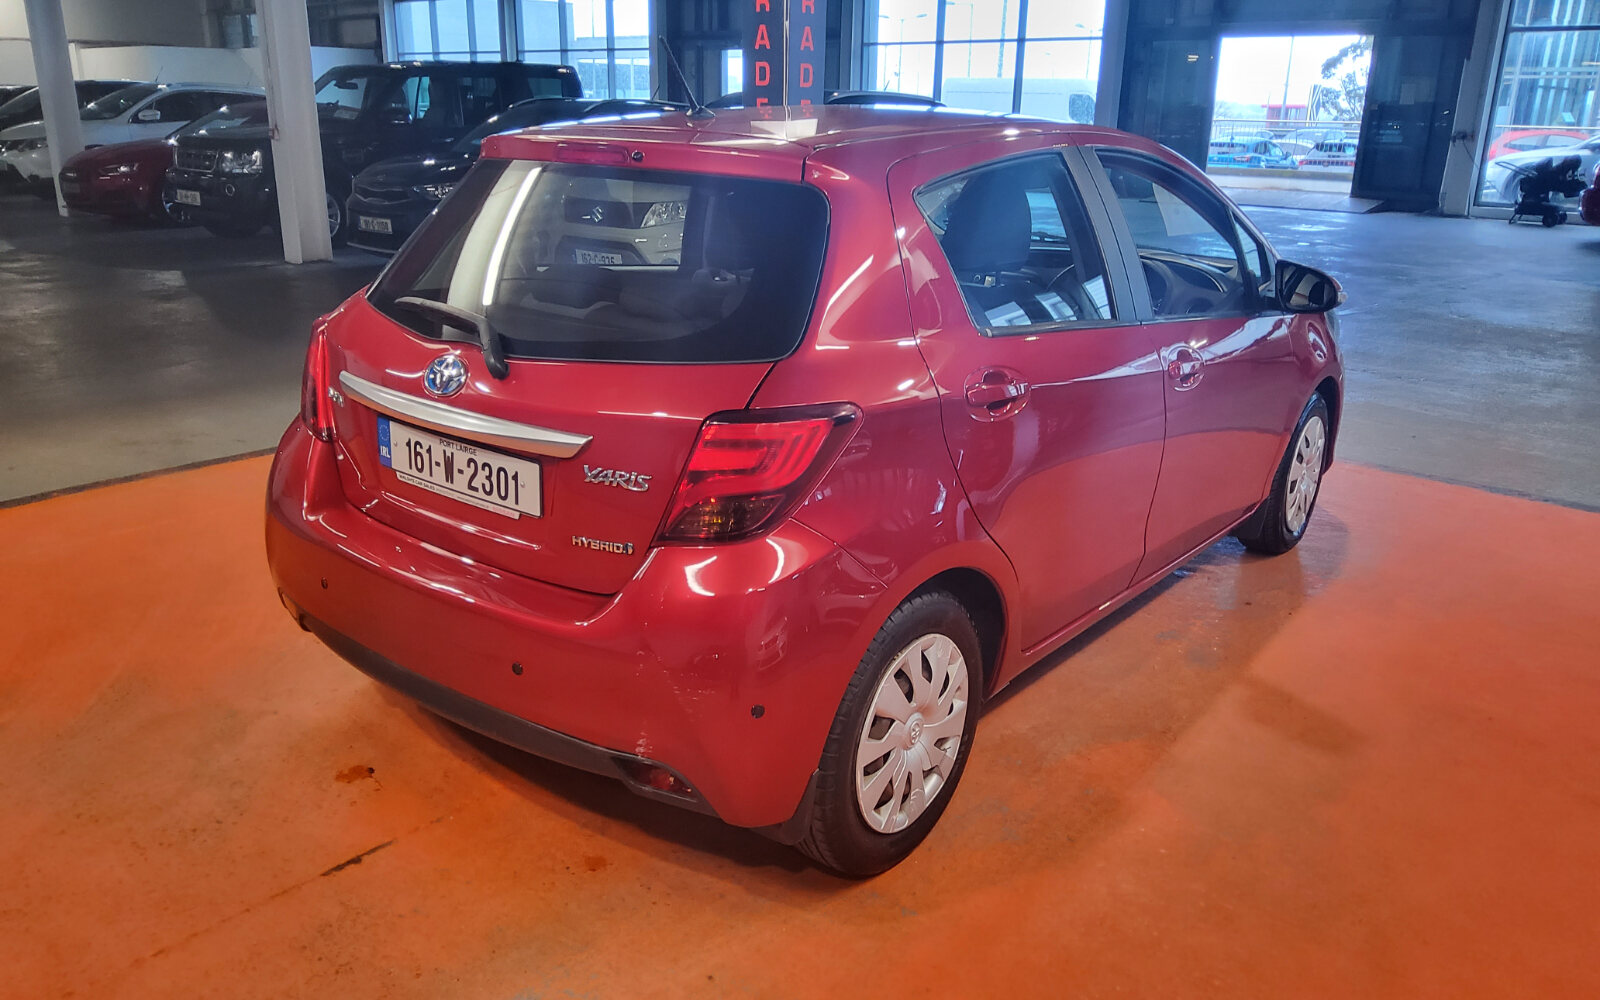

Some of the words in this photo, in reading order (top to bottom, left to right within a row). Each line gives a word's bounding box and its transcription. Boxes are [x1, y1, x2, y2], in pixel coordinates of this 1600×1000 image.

[439, 438, 454, 449] PORT
[380, 445, 390, 459] IRL
[406, 437, 519, 505] 161-W-2301
